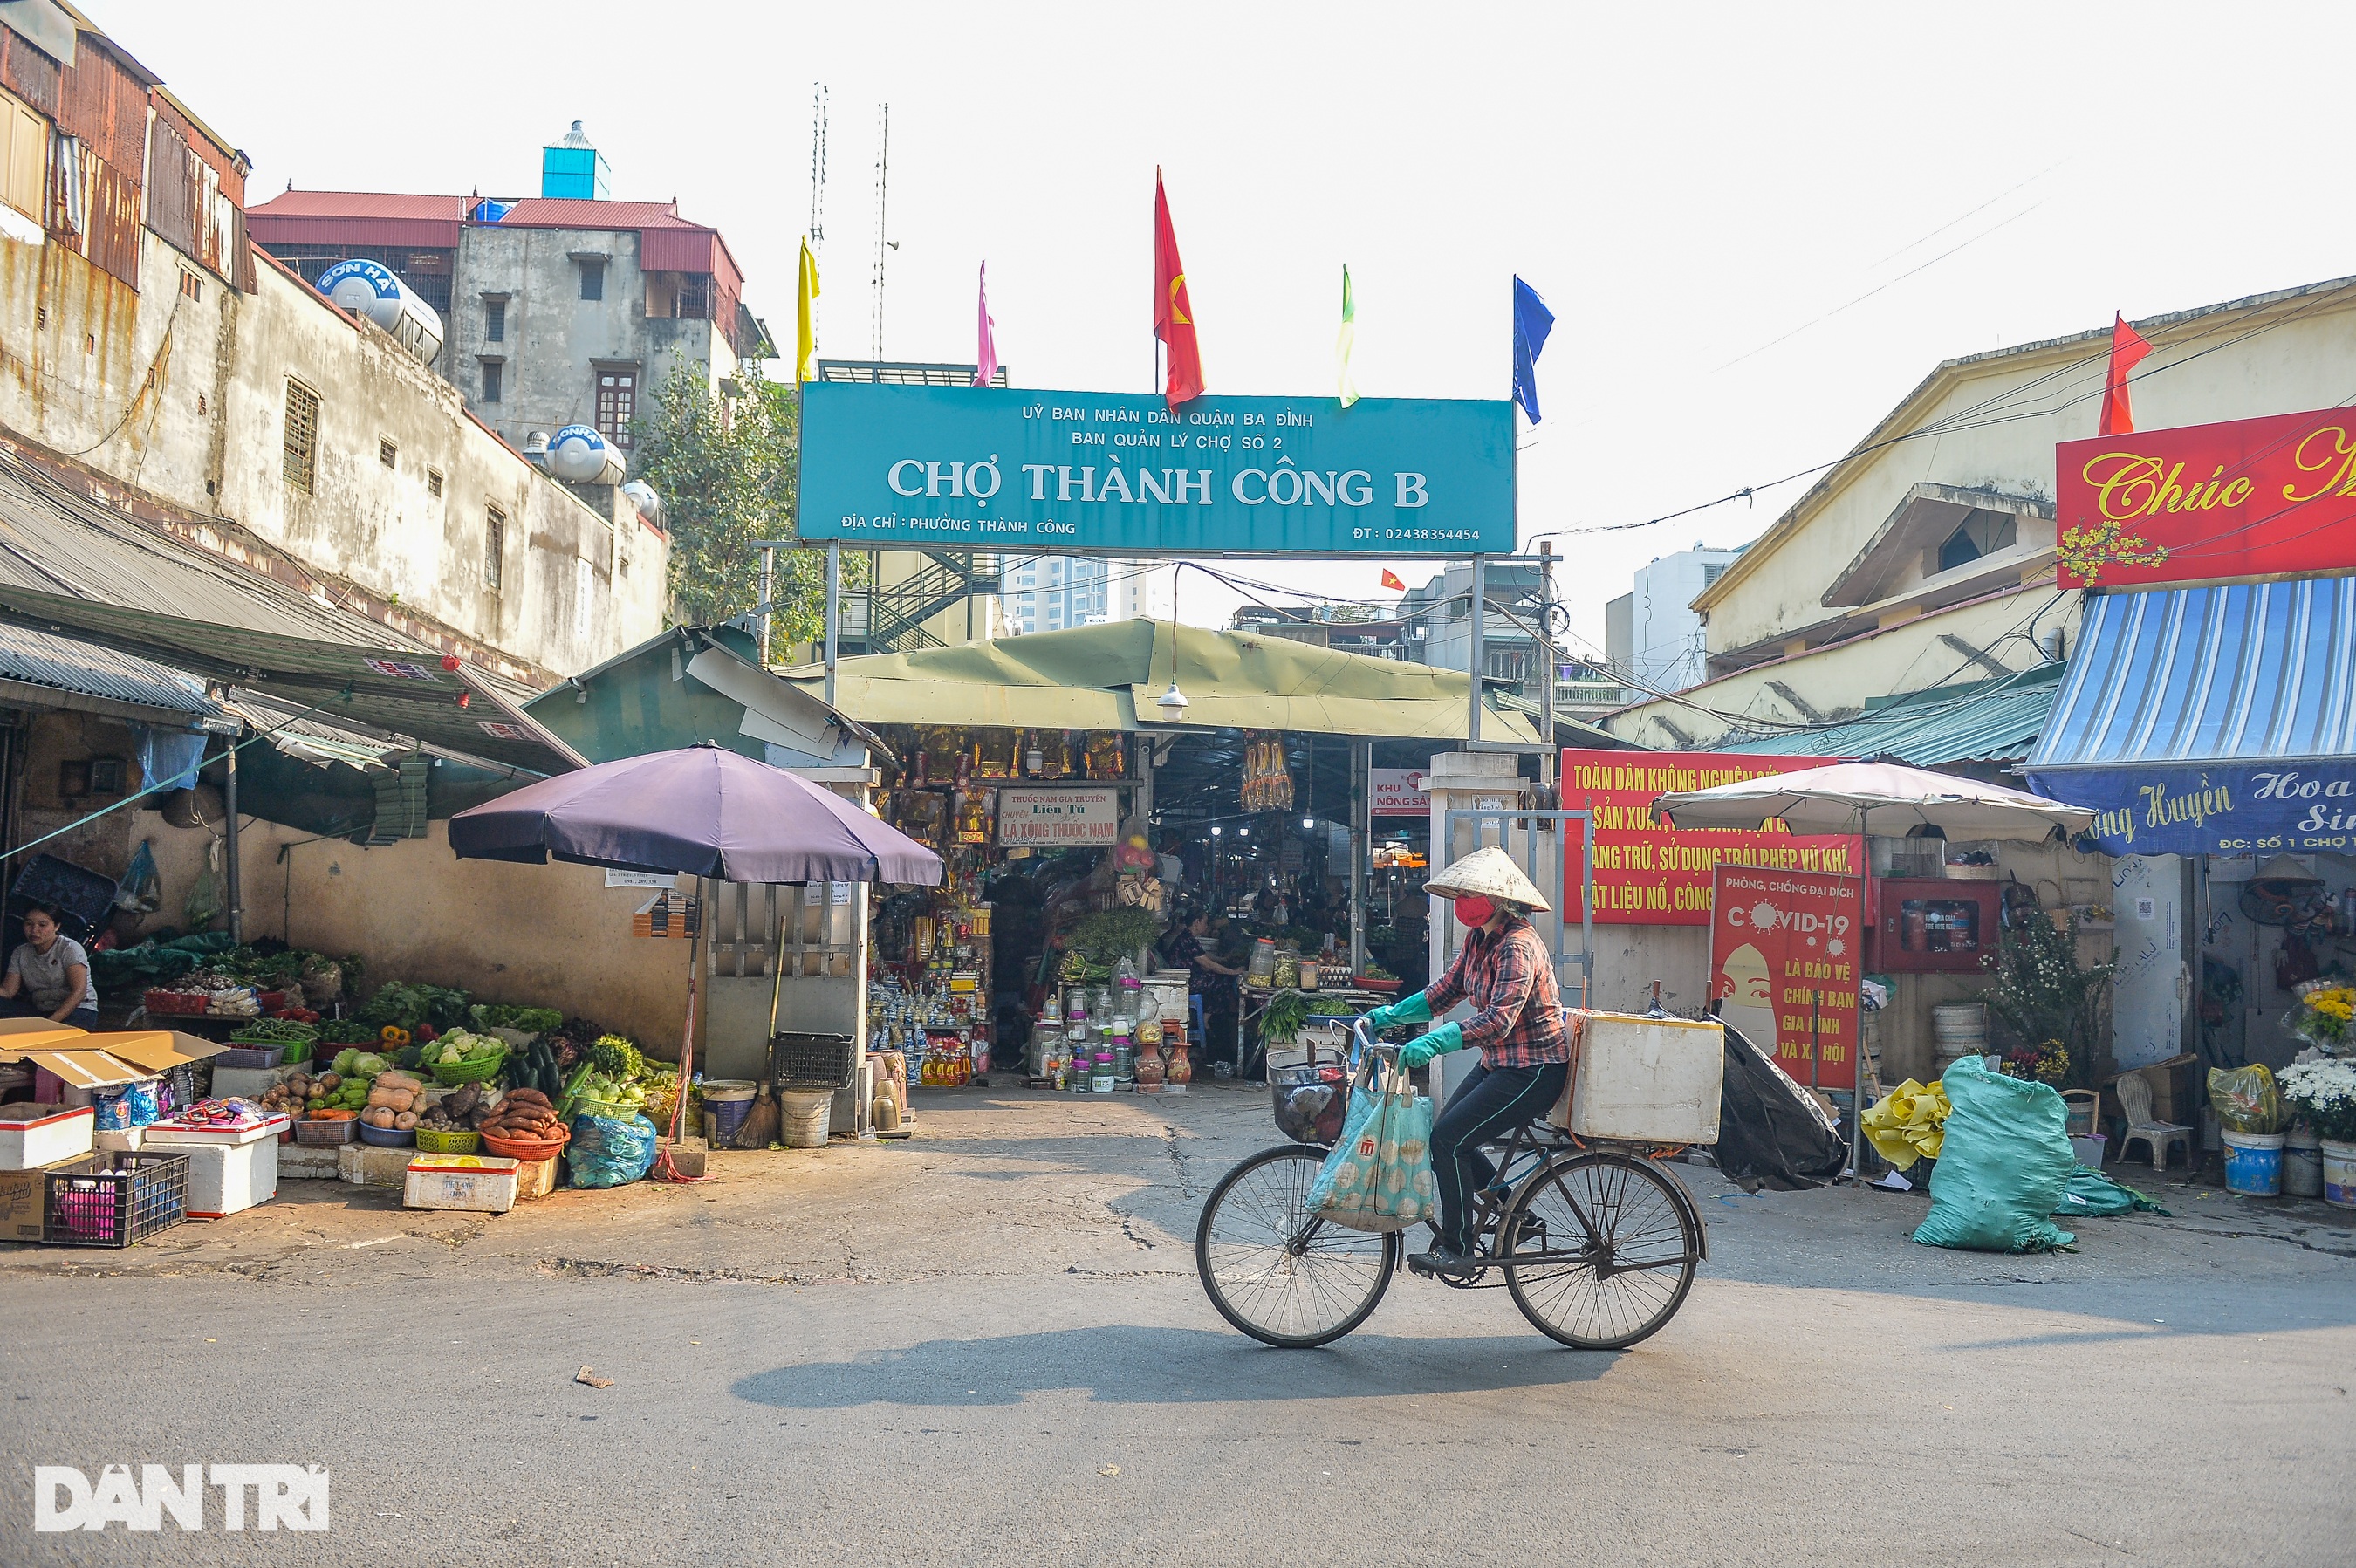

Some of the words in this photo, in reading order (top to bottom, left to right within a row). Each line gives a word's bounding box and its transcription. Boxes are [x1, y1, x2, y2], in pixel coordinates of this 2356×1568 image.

[1023, 403, 1044, 419] UỶ
[1052, 407, 1085, 421] BAN
[1094, 406, 1140, 422] NHÂN
[1147, 408, 1181, 424] DÂN
[1189, 409, 1235, 428] QUẬN
[1243, 413, 1266, 426] BA
[1276, 407, 1313, 427] ĐÌNH
[1072, 432, 1105, 445] BAN
[1113, 429, 1160, 447] QUẢN
[1170, 432, 1188, 448] LÝ
[1195, 435, 1232, 452] CHỢ
[1242, 433, 1265, 449] SỐ
[1273, 437, 1282, 449] 2
[887, 454, 1002, 508] CHỢ
[1021, 454, 1213, 504] THÀNH
[1231, 455, 1373, 506] CÔNG
[1394, 472, 1429, 508] B
[2082, 452, 2255, 519] Chúc
[841, 513, 866, 531] ĐỊA
[873, 512, 896, 529] CHỈ
[909, 513, 971, 531] PHƯỜNG
[977, 517, 1028, 532] THÀNH
[1036, 519, 1076, 534] CÔNG
[1385, 528, 1480, 540] 02438354454
[1574, 761, 1612, 790] TOÀN
[1615, 762, 1645, 791] DÂN
[1648, 763, 1696, 791] KHÔNG
[2251, 772, 2354, 799] Hoa
[1012, 794, 1038, 803] THUỐC
[1033, 804, 1062, 814] Liên
[1067, 804, 1085, 814] Tú
[1377, 795, 1409, 805] NÔNG
[2139, 773, 2235, 828] Huyền
[1593, 796, 1623, 829] SẢN
[1003, 820, 1017, 838] LÁ
[1020, 820, 1050, 838] XÔNG
[1052, 818, 1086, 838] THUỐC
[1089, 823, 1113, 837] NAM
[2219, 839, 2251, 849] ĐC:
[2257, 835, 2281, 848] SỐ
[2288, 838, 2295, 847] 1
[2304, 836, 2346, 849] CHỢ
[1623, 840, 1656, 873] TRỮ,
[1659, 837, 1681, 871] SỬ
[1681, 847, 1722, 876] DỤNG
[1723, 843, 1757, 866] TRÁI
[1759, 844, 1798, 869] PHÉP
[1800, 844, 1819, 872] VŨ
[1611, 880, 1643, 915] LIỆU
[1646, 877, 1672, 913] NỔ,
[1726, 876, 1766, 892] PHÒNG,
[1769, 878, 1807, 894] CHỐNG
[1809, 885, 1827, 898] ĐẠI
[1784, 958, 1801, 976] LÀ
[1805, 958, 1832, 979] BẢO
[1835, 962, 1850, 984] VỆ
[1828, 990, 1855, 1011] BẠN
[1783, 1015, 1805, 1032] GIA
[1781, 1039, 1798, 1058] VÀ
[1823, 1043, 1845, 1065] HỘI
